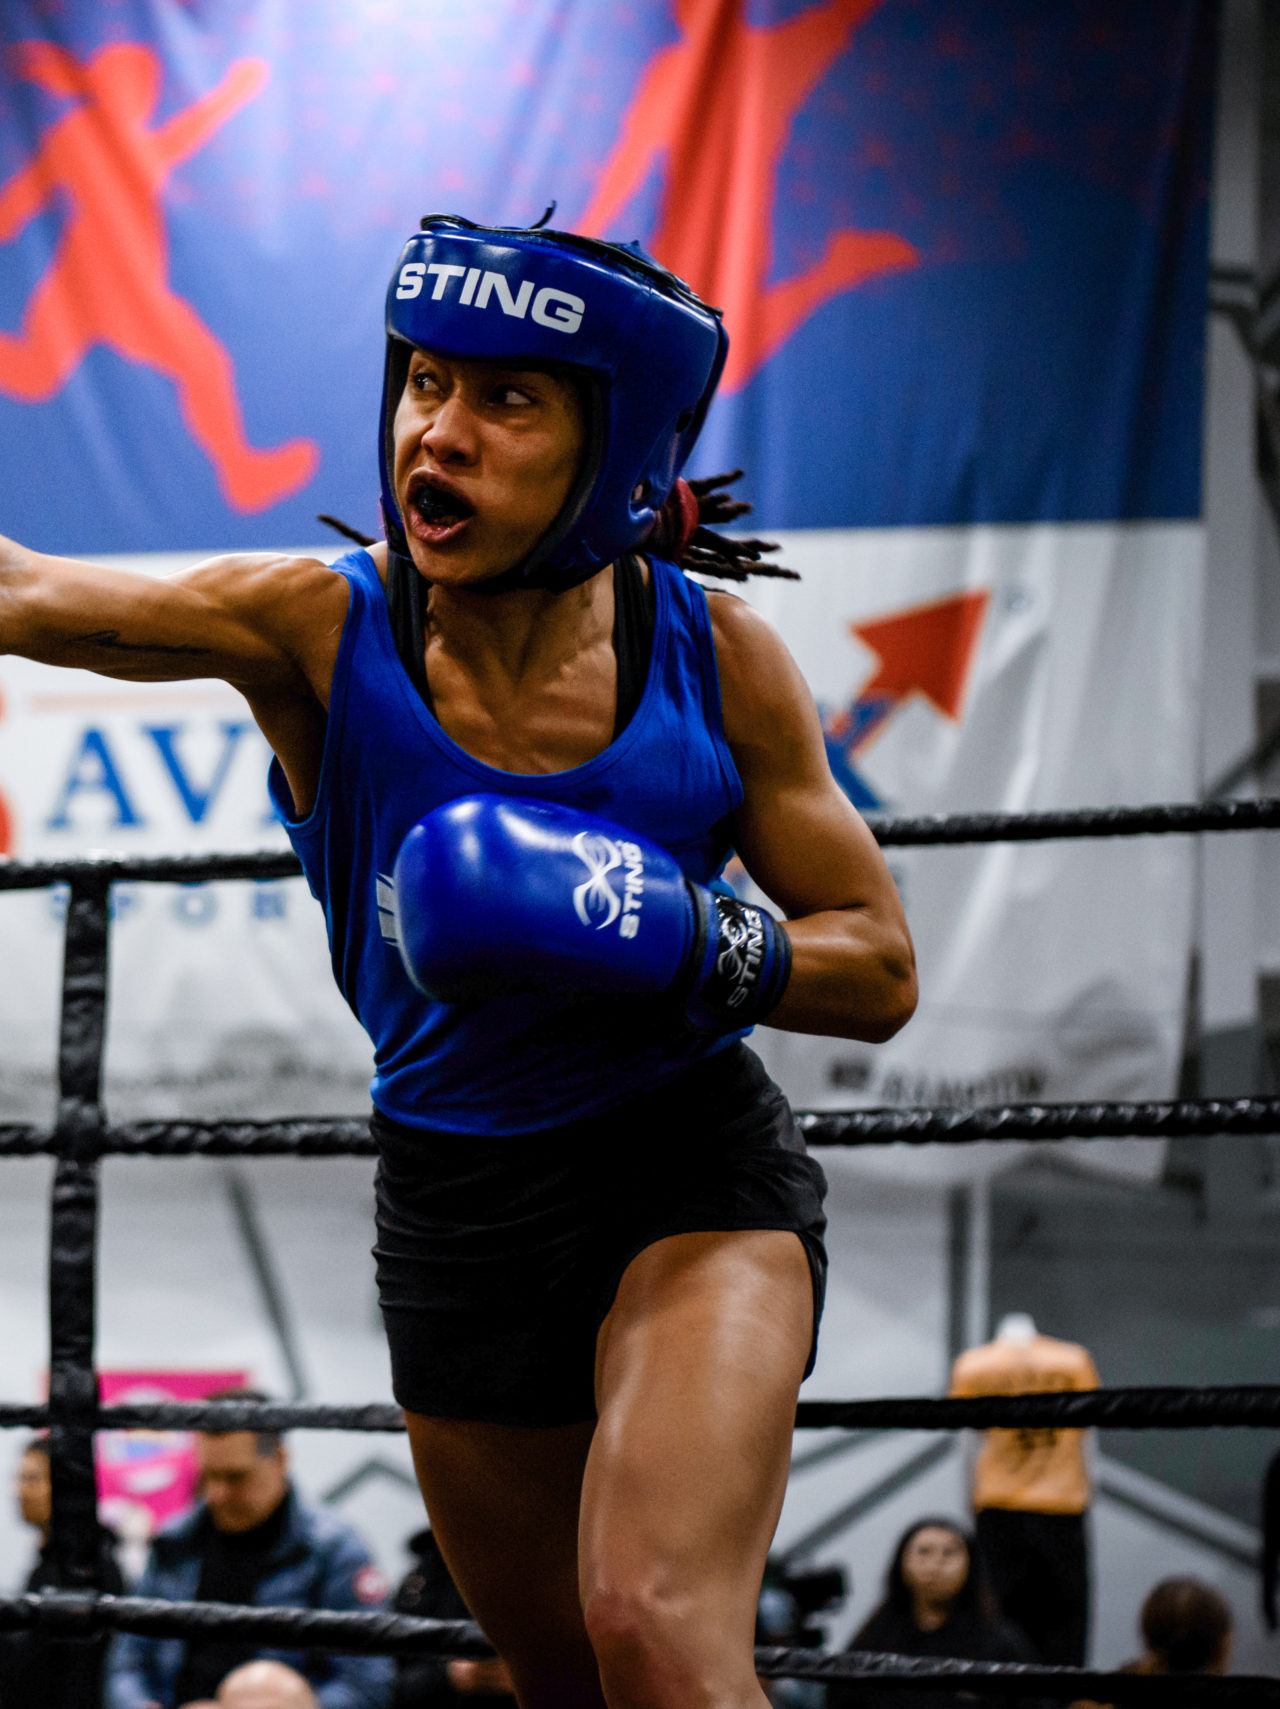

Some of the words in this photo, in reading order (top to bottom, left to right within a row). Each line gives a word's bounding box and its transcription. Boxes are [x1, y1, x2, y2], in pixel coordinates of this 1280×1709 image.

[396, 263, 586, 334] STING
[618, 840, 644, 940] STING
[726, 906, 766, 1008] STING
